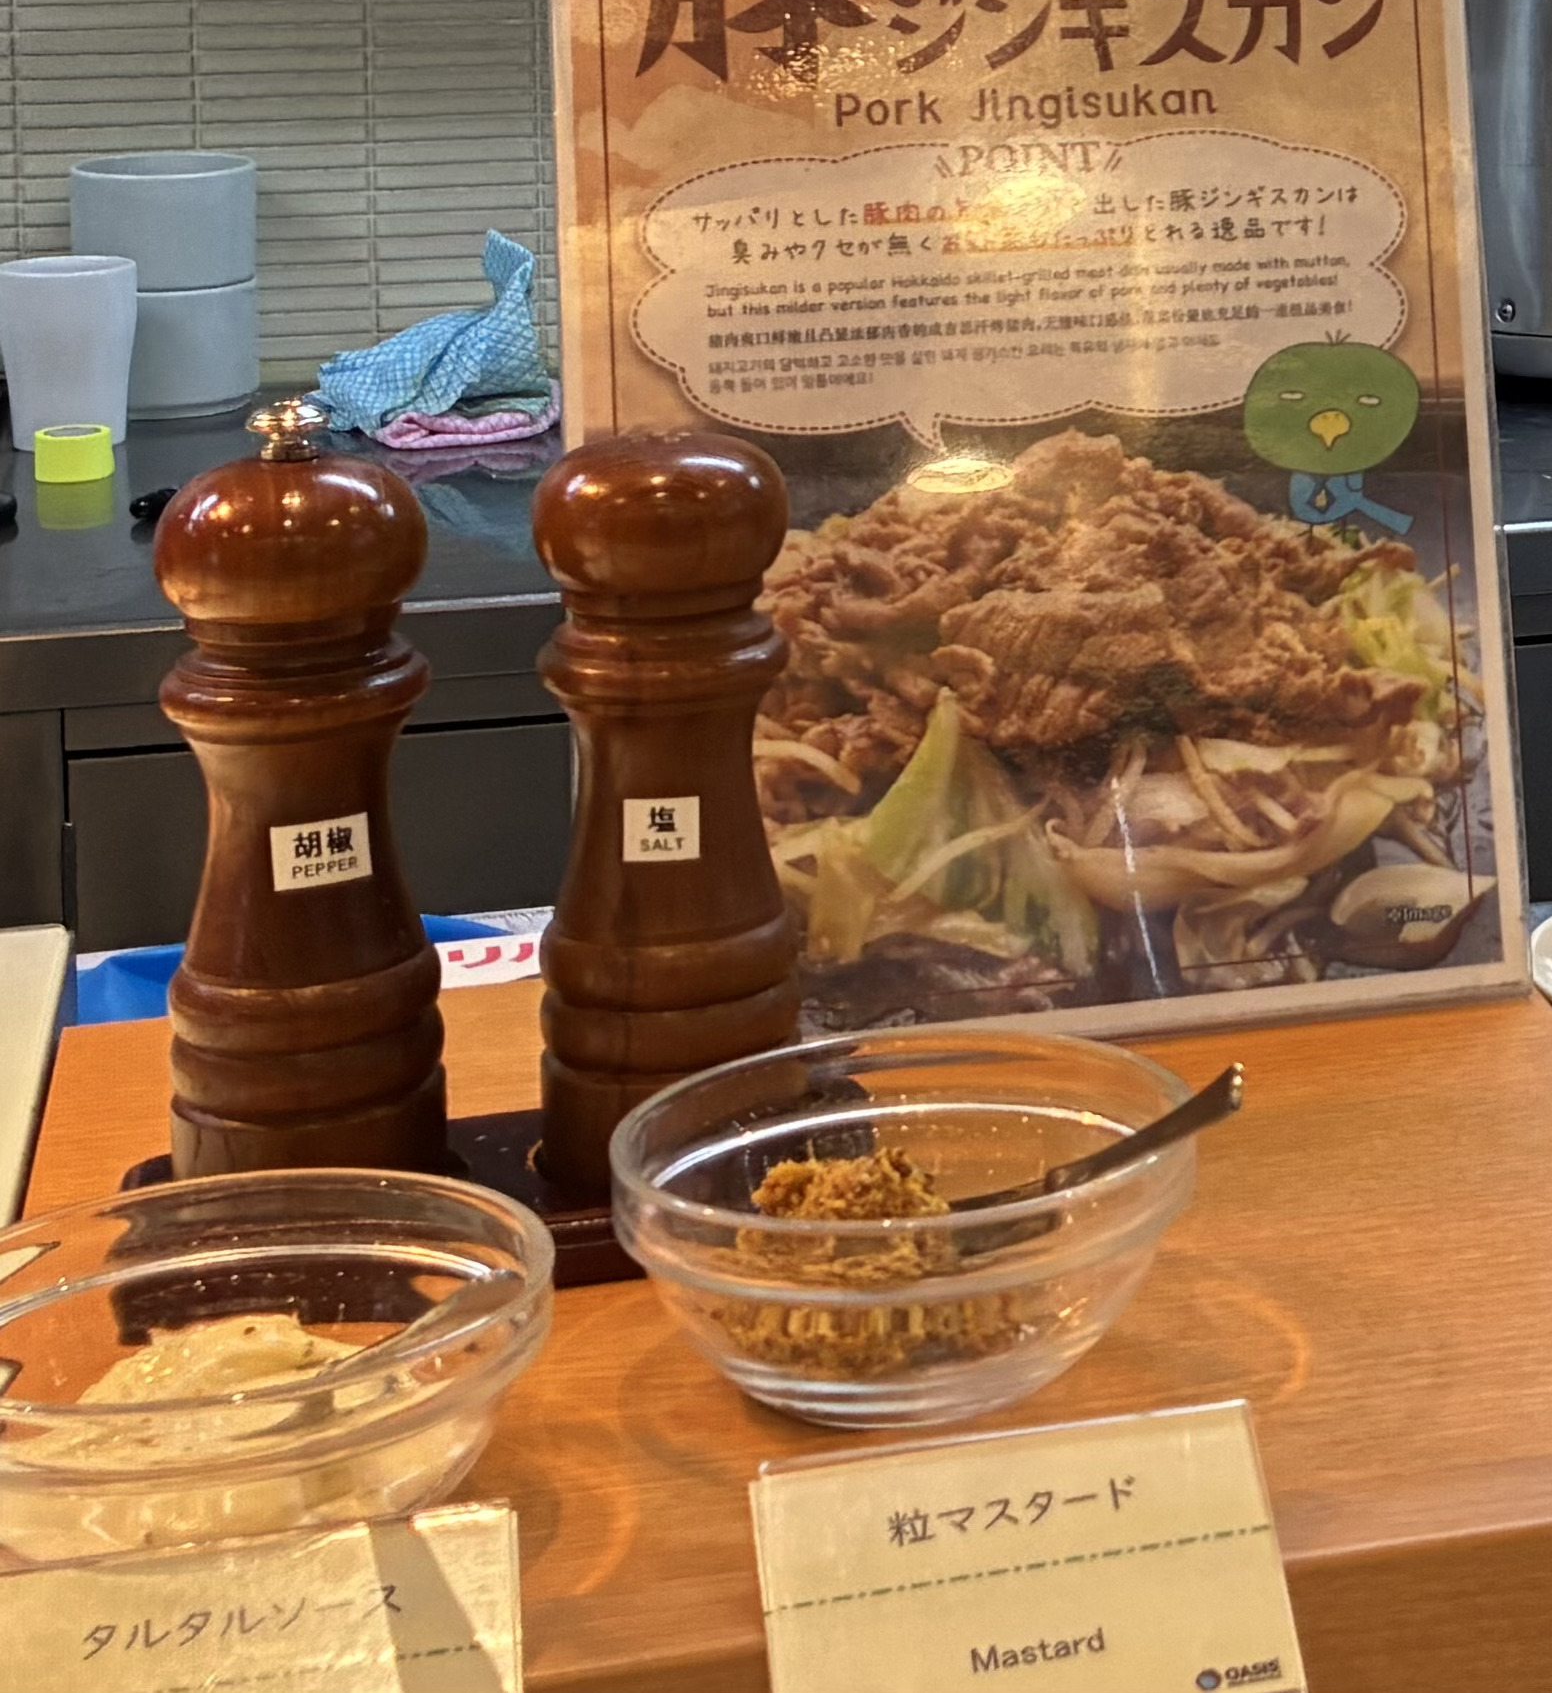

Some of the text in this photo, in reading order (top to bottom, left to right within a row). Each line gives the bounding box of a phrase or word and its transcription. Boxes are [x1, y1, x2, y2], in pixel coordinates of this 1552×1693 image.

[835, 83, 1219, 129] Pork Jingisukan
[706, 303, 734, 318] but
[742, 301, 770, 316] this
[648, 806, 677, 833] 塩
[293, 826, 354, 860] 胡椒
[640, 836, 685, 853] SALT
[291, 856, 359, 880] PEPPER
[888, 1474, 1136, 1548] 粒マスタード
[82, 1583, 401, 1662] タルタルソース
[969, 1626, 1106, 1674] Mastard
